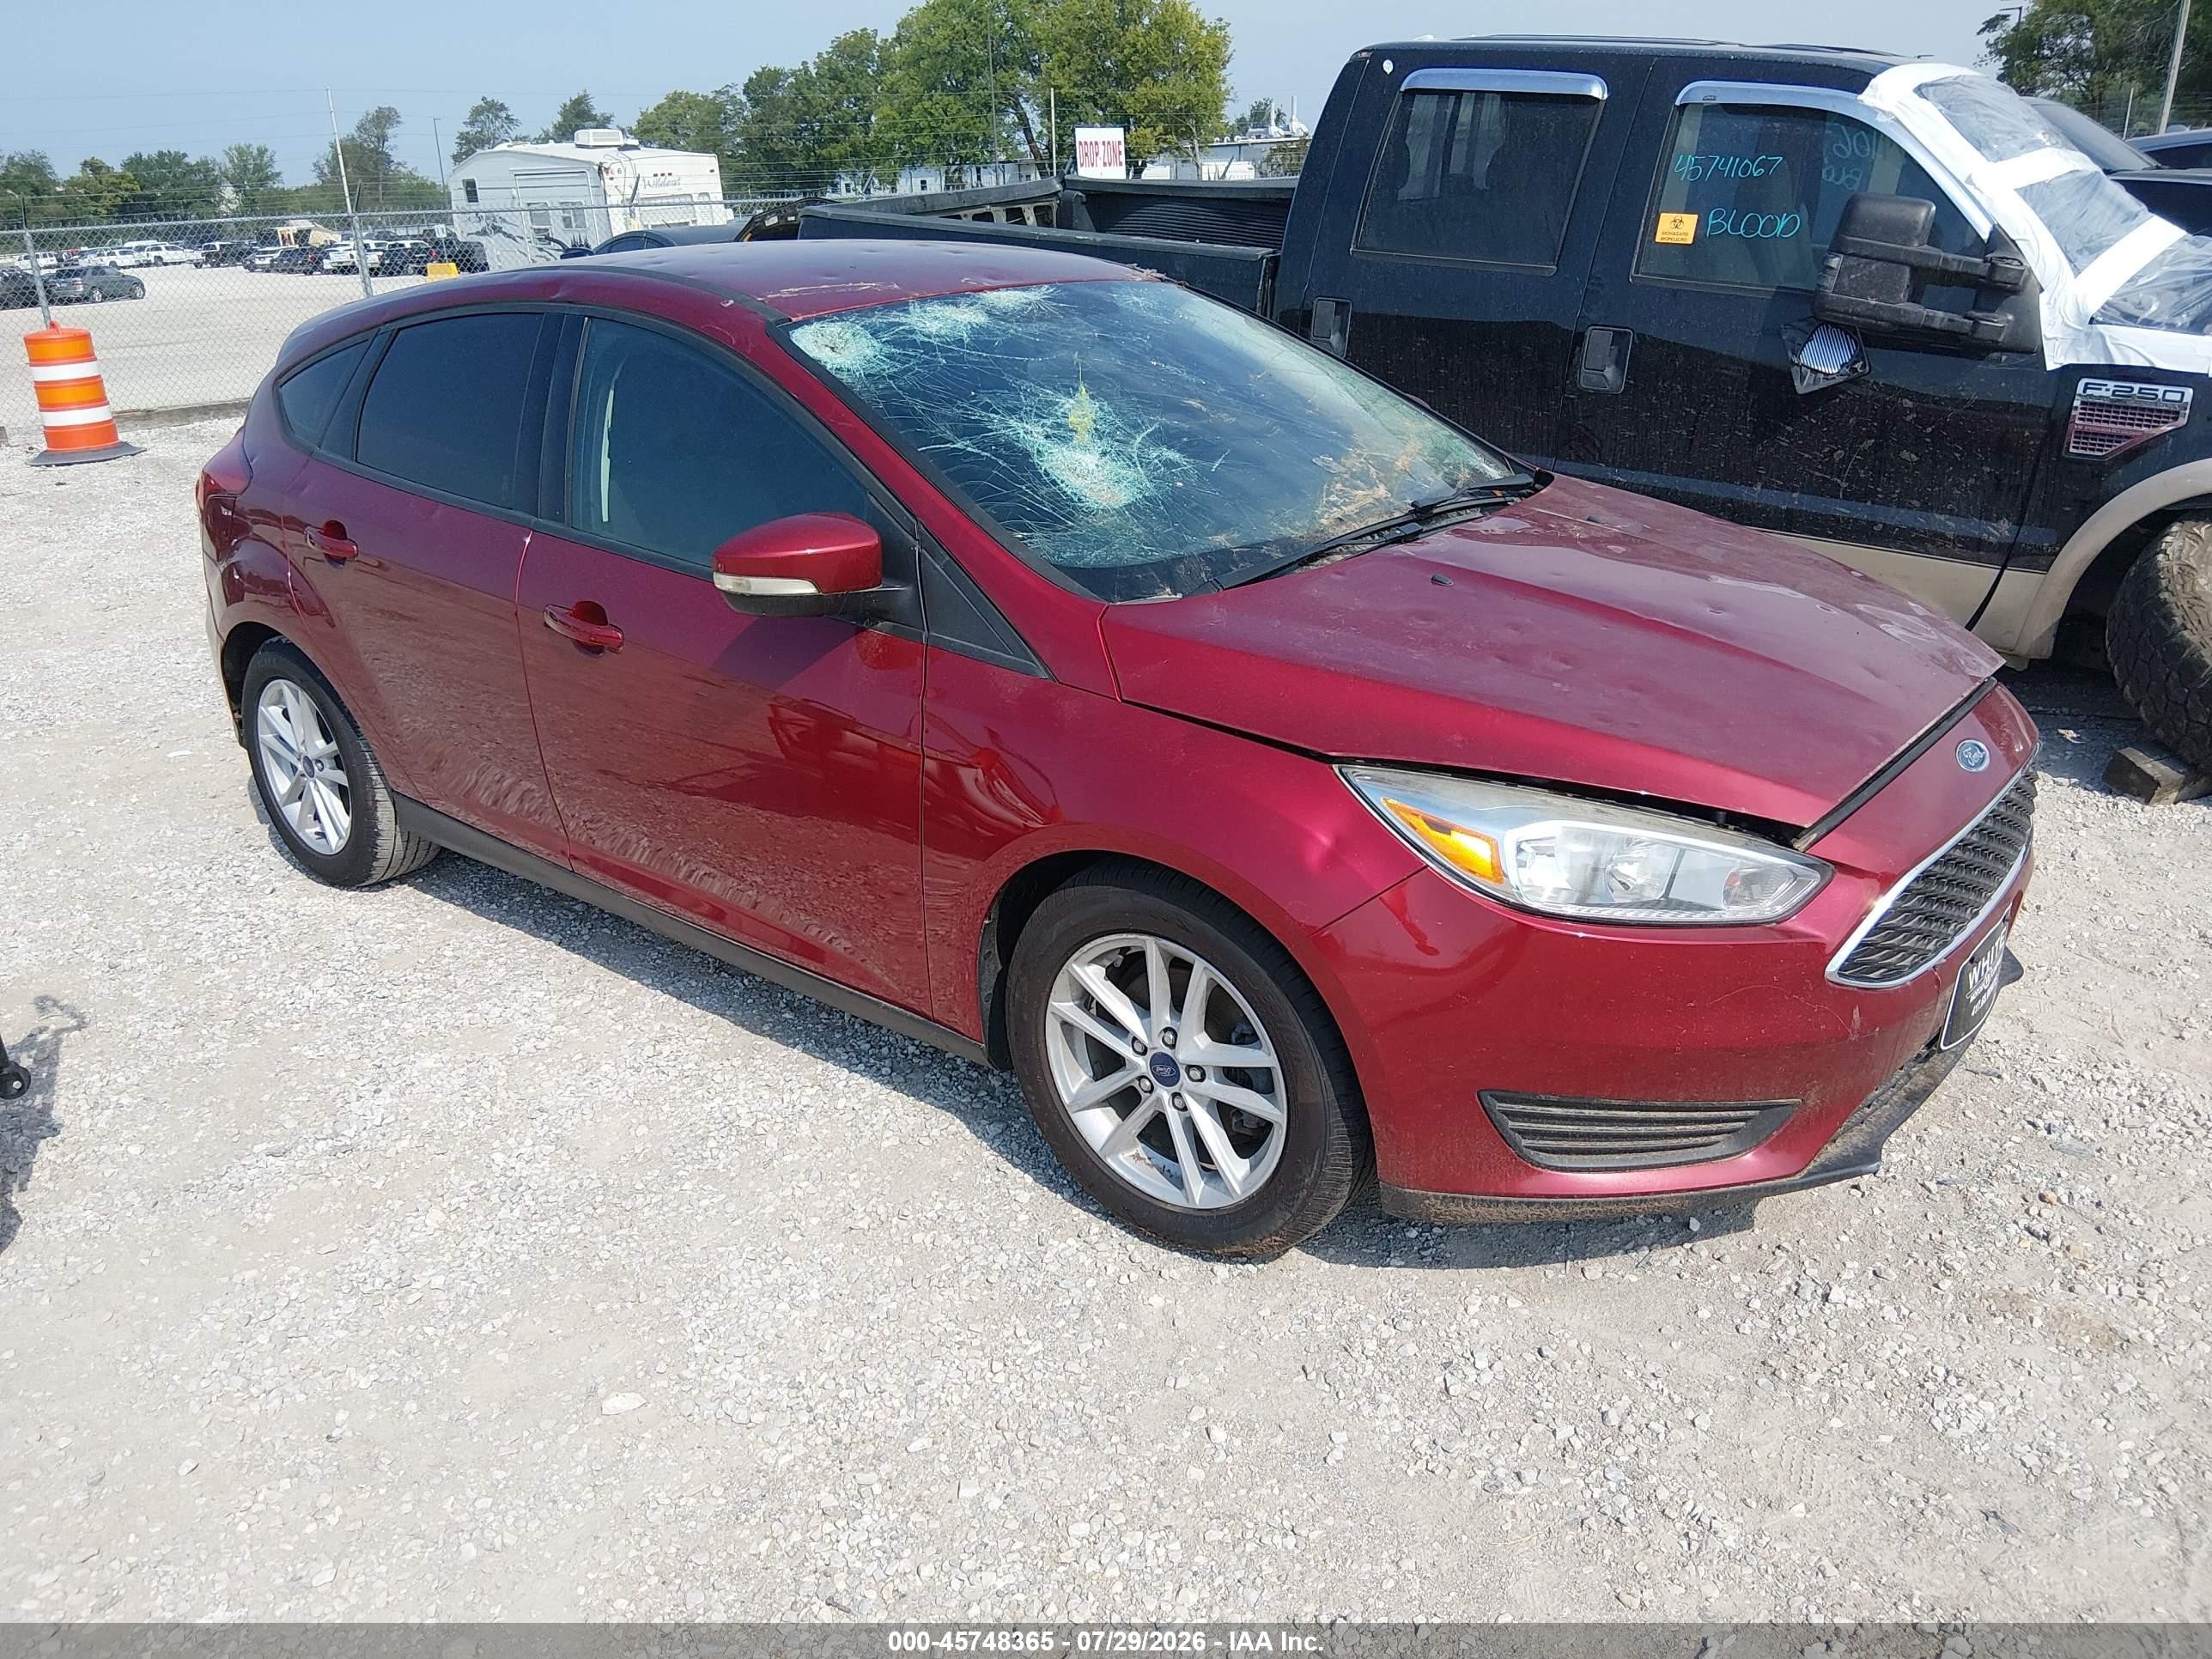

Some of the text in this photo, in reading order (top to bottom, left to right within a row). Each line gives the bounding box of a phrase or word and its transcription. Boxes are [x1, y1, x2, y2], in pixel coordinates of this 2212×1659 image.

[1079, 140, 1122, 167] DROP ZONE
[1674, 155, 1784, 182] 45741067
[1706, 208, 1801, 238] BLOOD
[2082, 382, 2185, 404] F-250
[1962, 745, 1985, 766] Ford
[1968, 926, 2007, 990] WHITE
